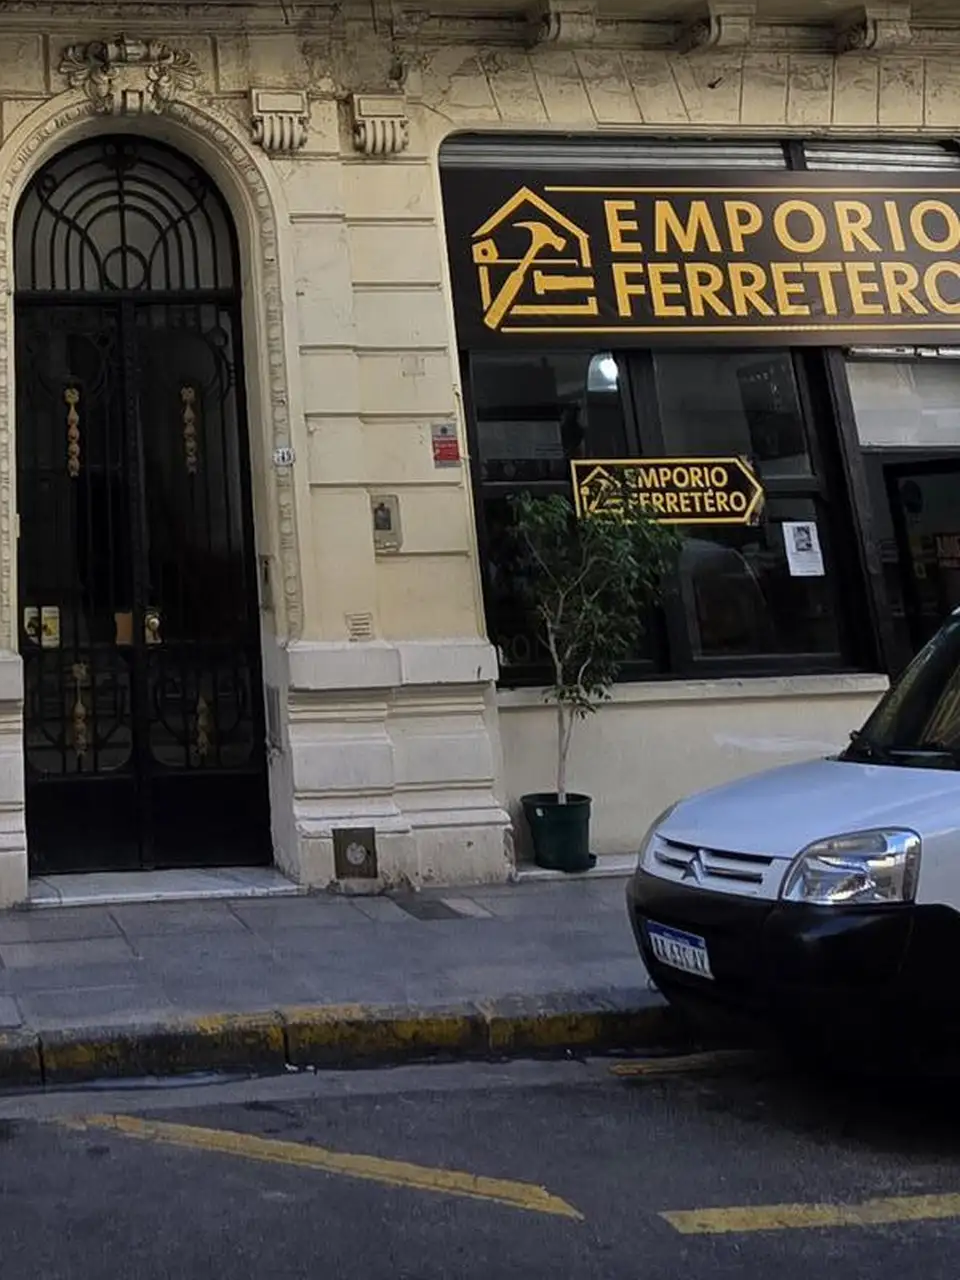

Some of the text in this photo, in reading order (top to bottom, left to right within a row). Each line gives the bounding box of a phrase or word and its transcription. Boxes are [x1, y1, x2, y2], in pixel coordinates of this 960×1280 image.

[604, 199, 960, 253] EMPORIO
[612, 260, 960, 317] FERRETERO
[624, 466, 728, 489] EMPORIO
